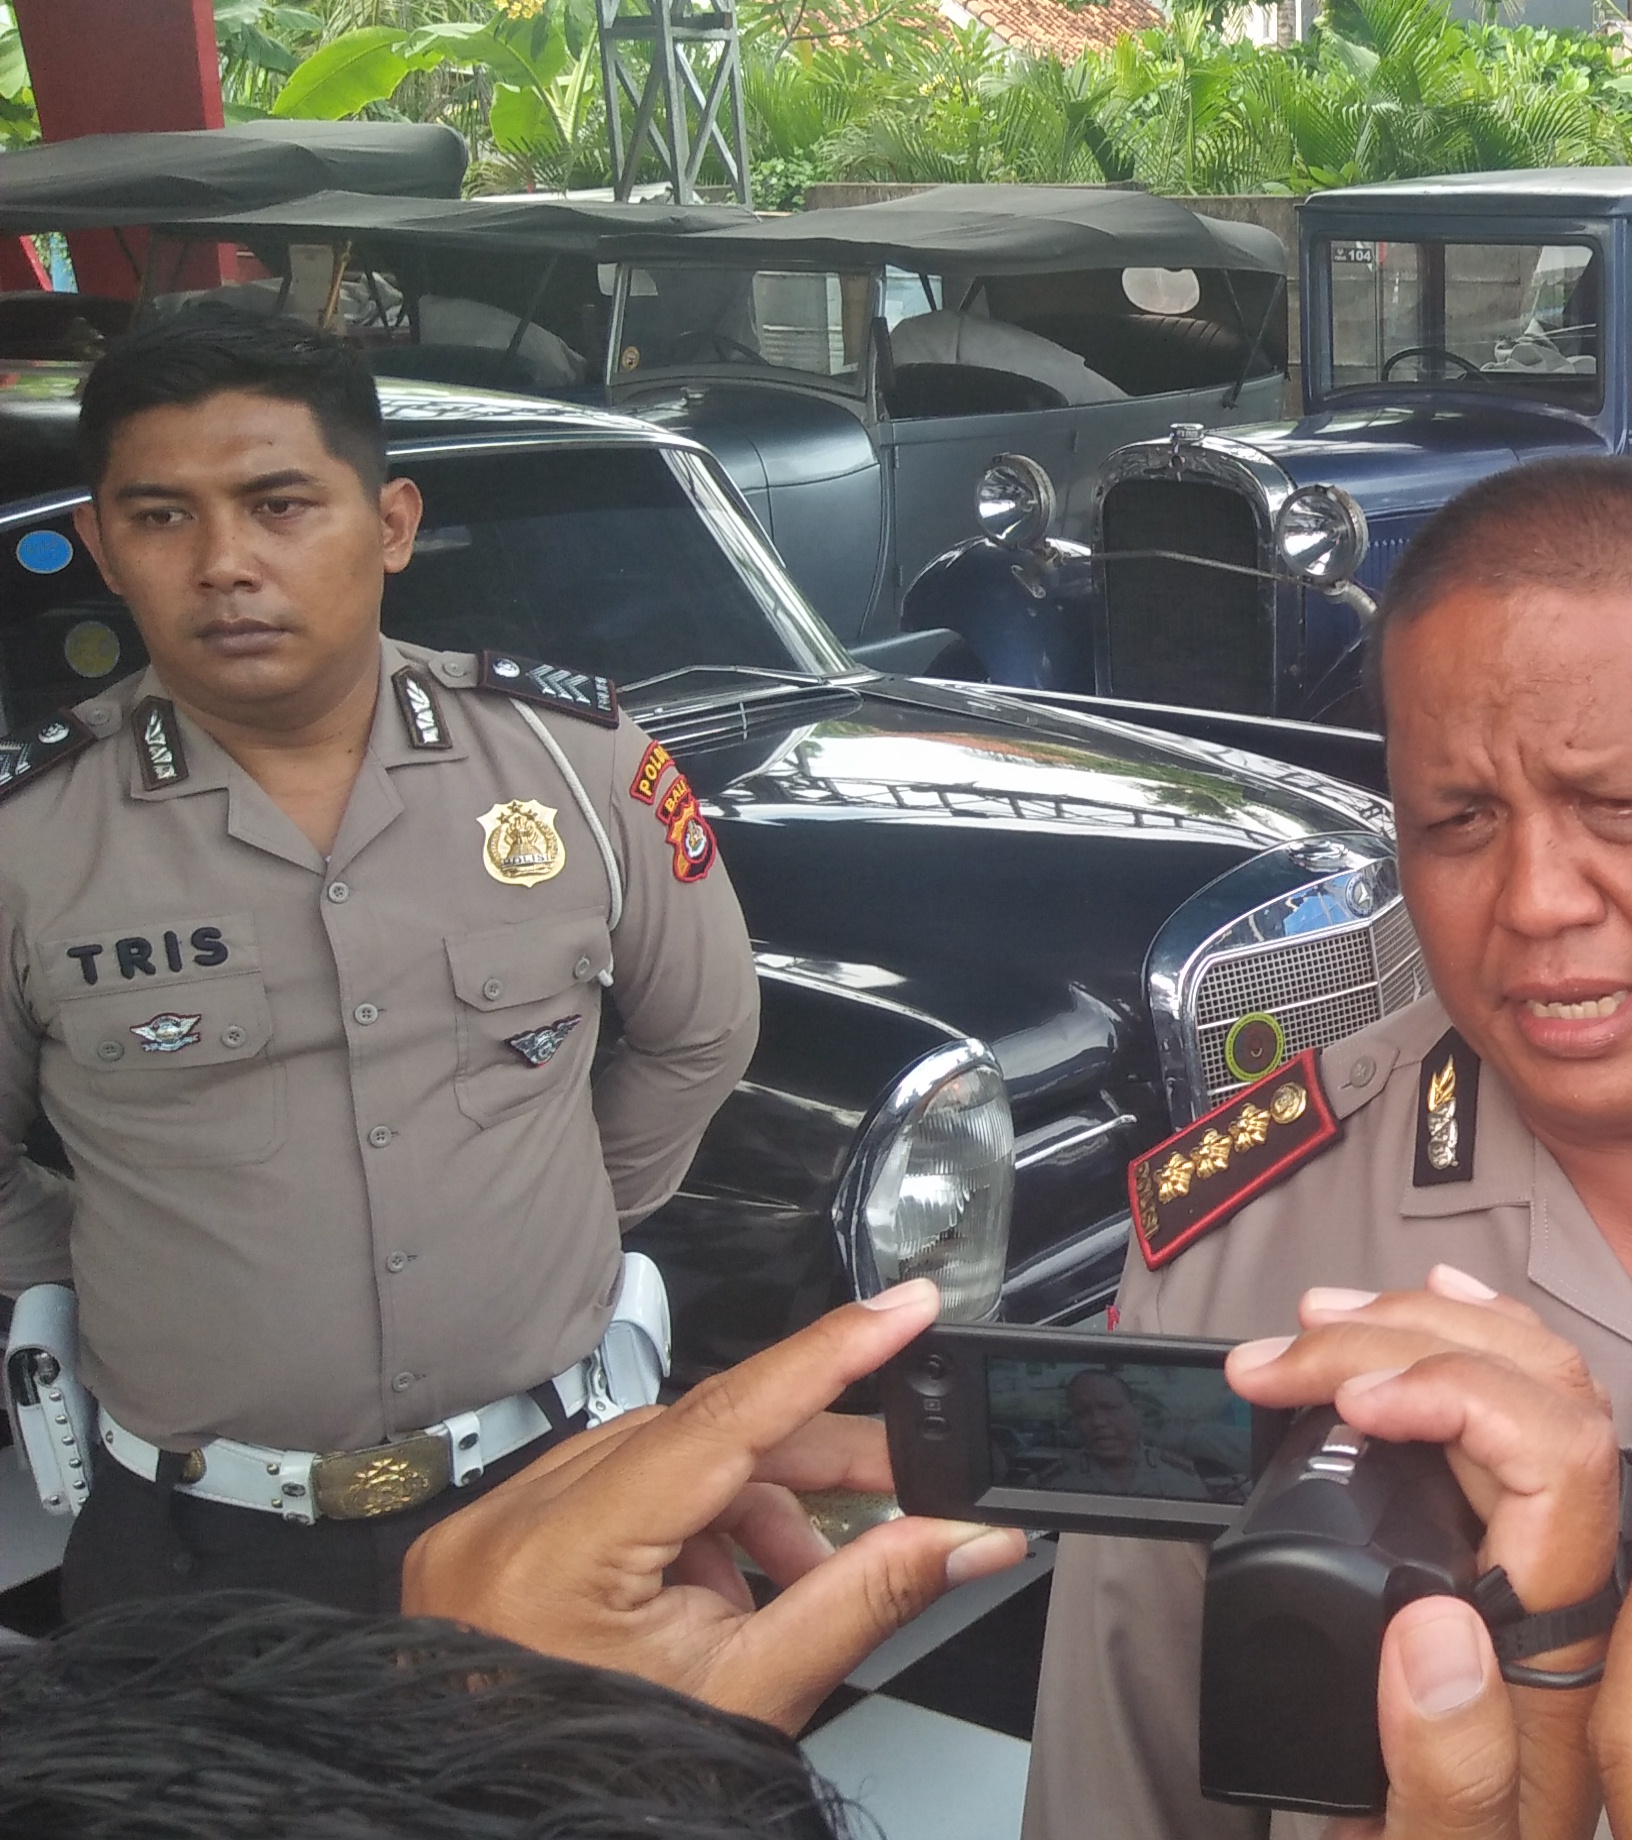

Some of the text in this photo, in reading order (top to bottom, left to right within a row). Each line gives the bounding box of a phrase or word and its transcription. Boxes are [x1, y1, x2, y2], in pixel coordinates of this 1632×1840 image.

[1349, 249, 1372, 262] 104
[664, 780, 688, 813] BALI
[67, 927, 228, 985] TRIS
